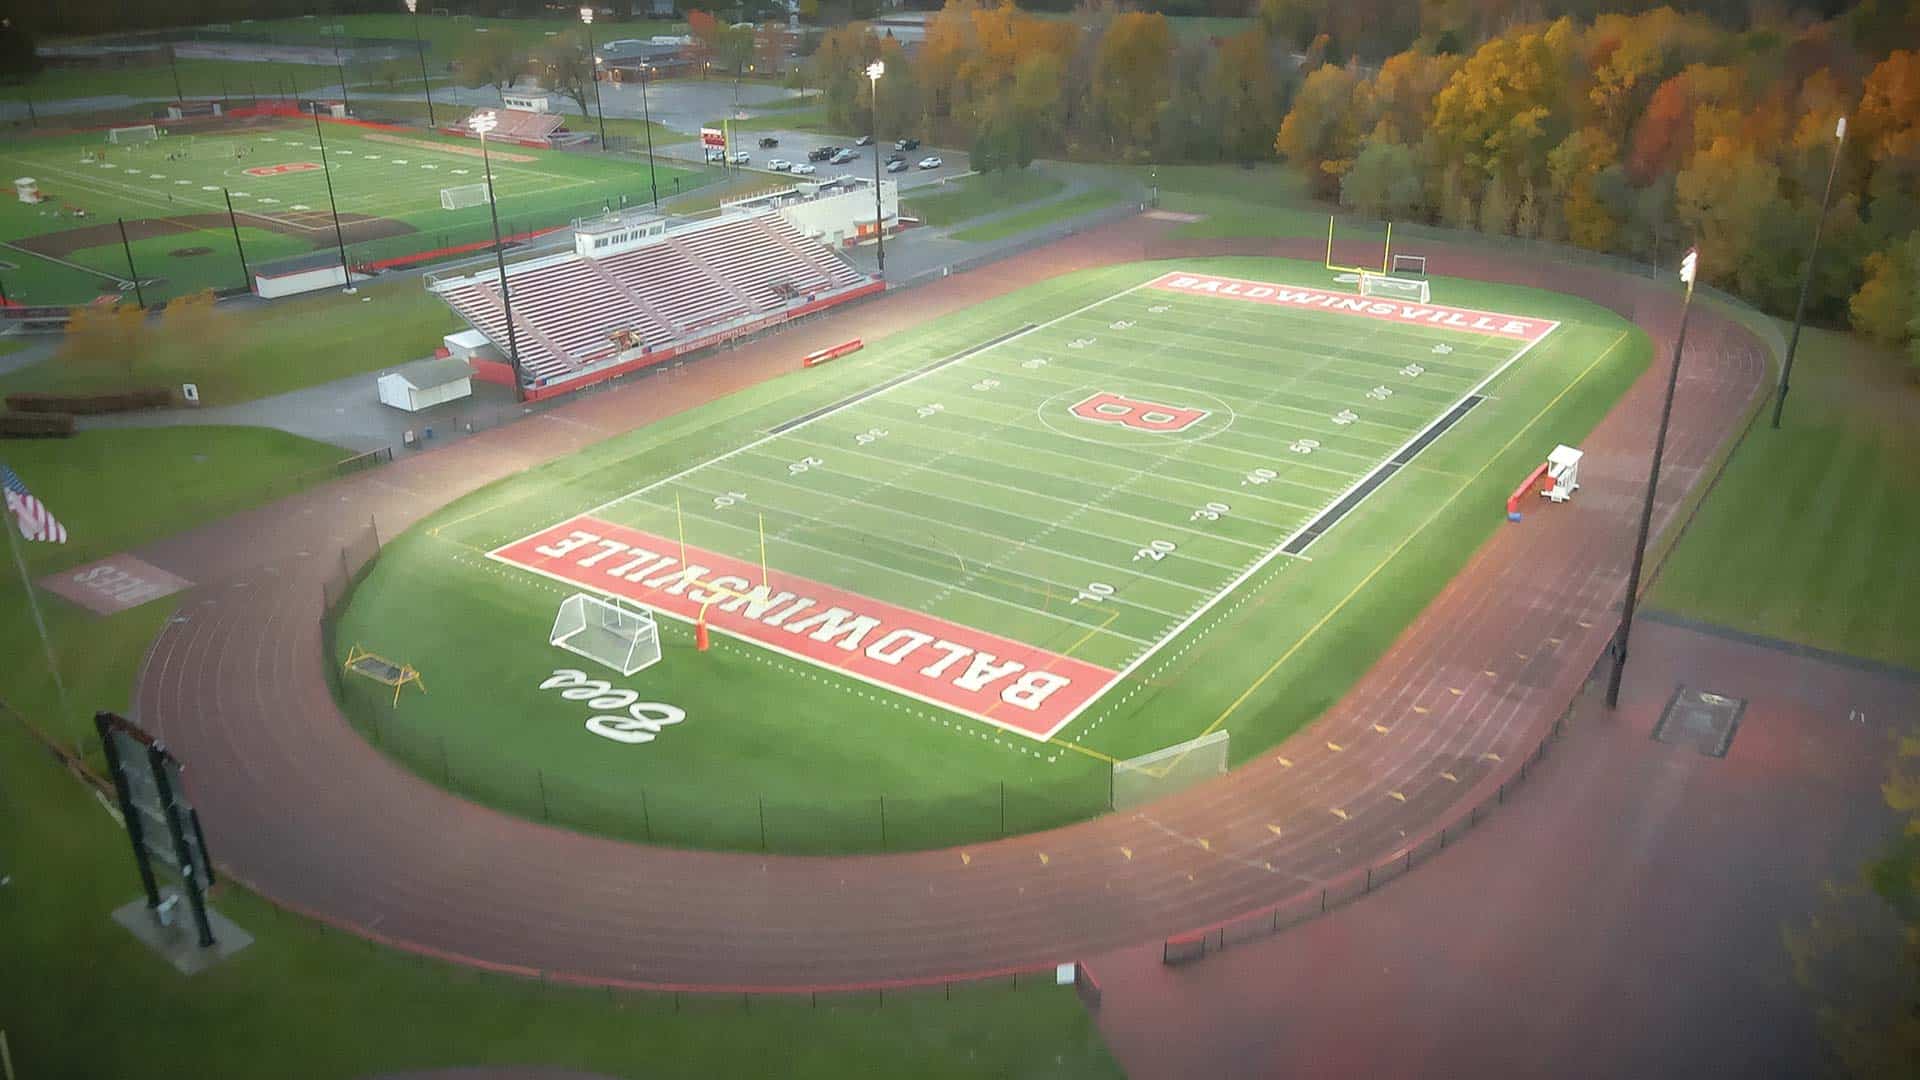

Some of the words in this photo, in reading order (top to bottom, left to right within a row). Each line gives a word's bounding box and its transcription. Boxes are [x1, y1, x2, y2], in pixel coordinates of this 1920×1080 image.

[1167, 275, 1534, 335] BALDWINSVILLE
[1068, 391, 1212, 433] B
[1289, 439, 1320, 454] 50
[789, 457, 822, 472] 20
[713, 492, 746, 506] 10
[1195, 502, 1231, 520] 30
[1139, 540, 1177, 561] 20
[1079, 582, 1116, 601] 10
[535, 530, 1072, 711] BALDWINSVILLE
[538, 668, 687, 744] Bees
